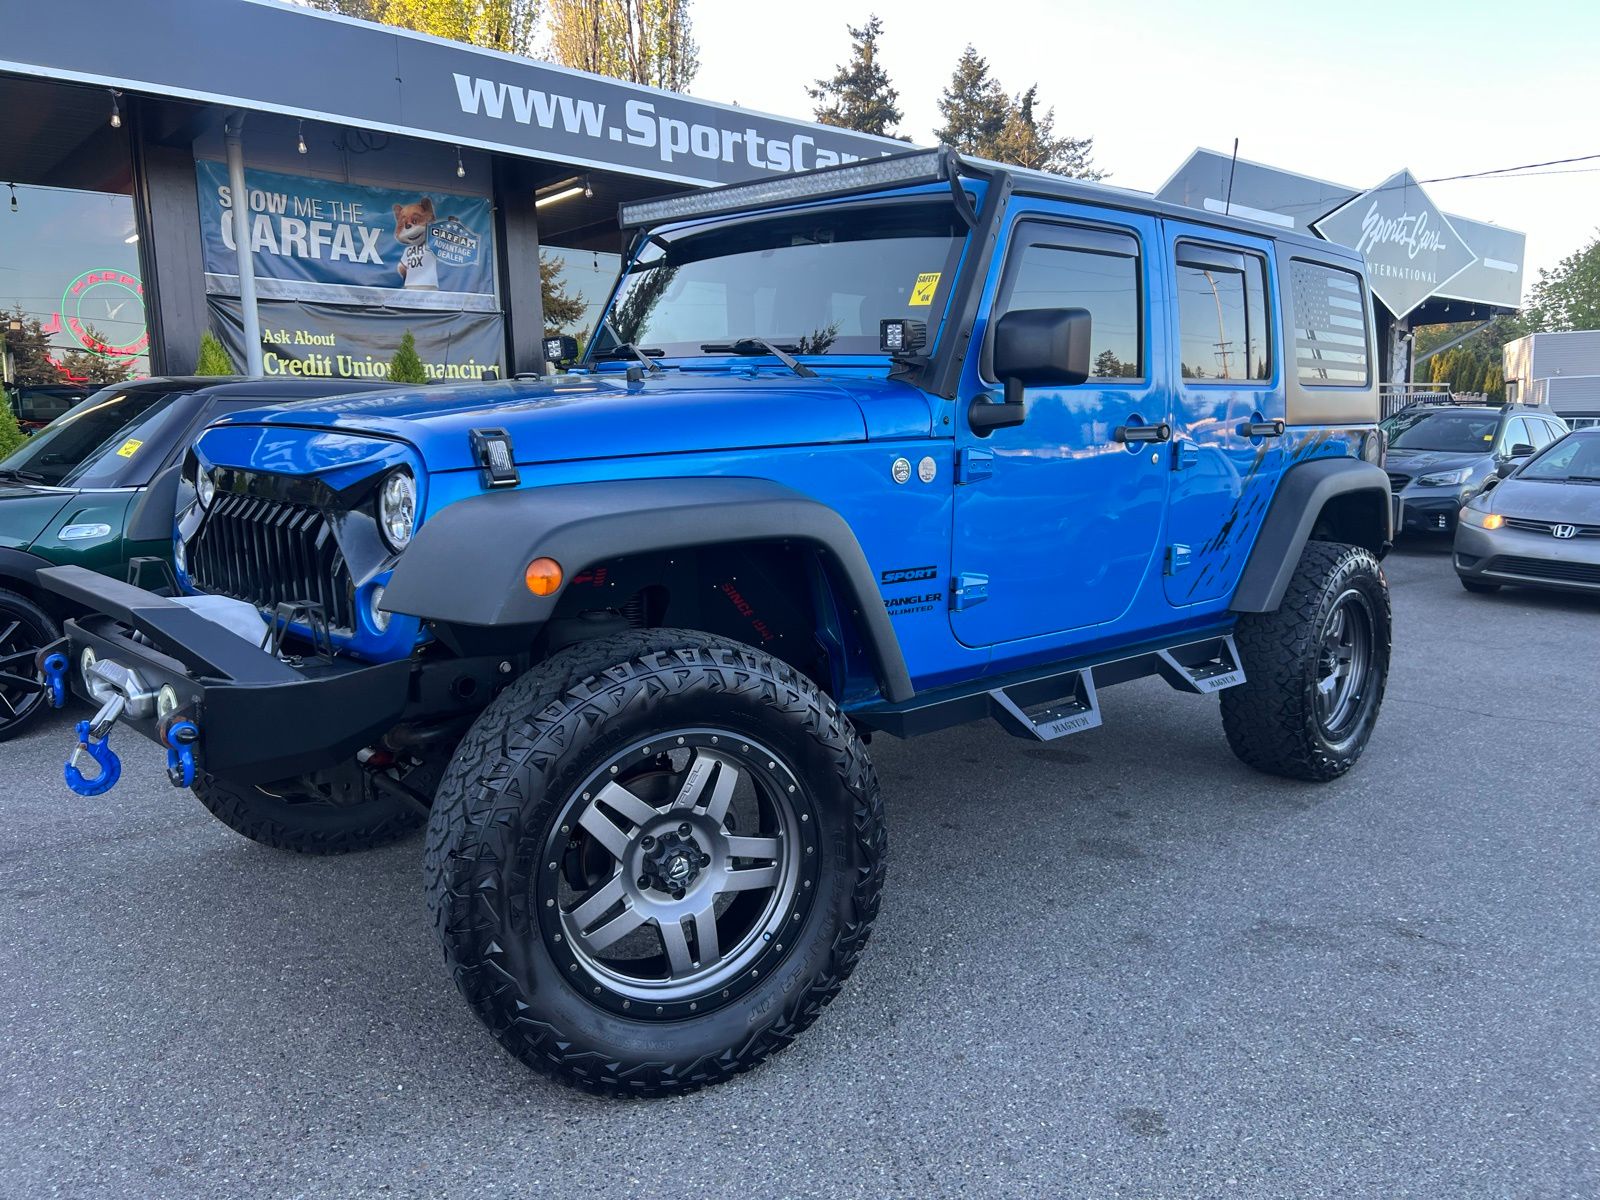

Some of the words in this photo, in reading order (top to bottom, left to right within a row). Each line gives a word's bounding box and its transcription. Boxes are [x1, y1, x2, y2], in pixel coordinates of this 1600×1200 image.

[218, 186, 287, 214] SOW
[294, 196, 324, 219] ME
[327, 201, 363, 224] THE
[432, 228, 476, 248] CARFAX
[407, 245, 424, 257] CAR
[434, 240, 472, 257] ADVANTAGE
[437, 250, 464, 263] DEALER
[407, 256, 423, 268] FOX
[1366, 262, 1437, 283] NTERNATIONAL
[263, 329, 291, 344] Ask
[294, 330, 336, 346] About
[263, 352, 333, 376] Credit
[881, 566, 937, 584] SPORT
[884, 593, 942, 607] RANGLER
[887, 605, 934, 616] NLIMITED
[1208, 675, 1237, 688] MAGNUM
[1052, 717, 1089, 734] MAGNUM
[679, 764, 703, 805] FUEL
